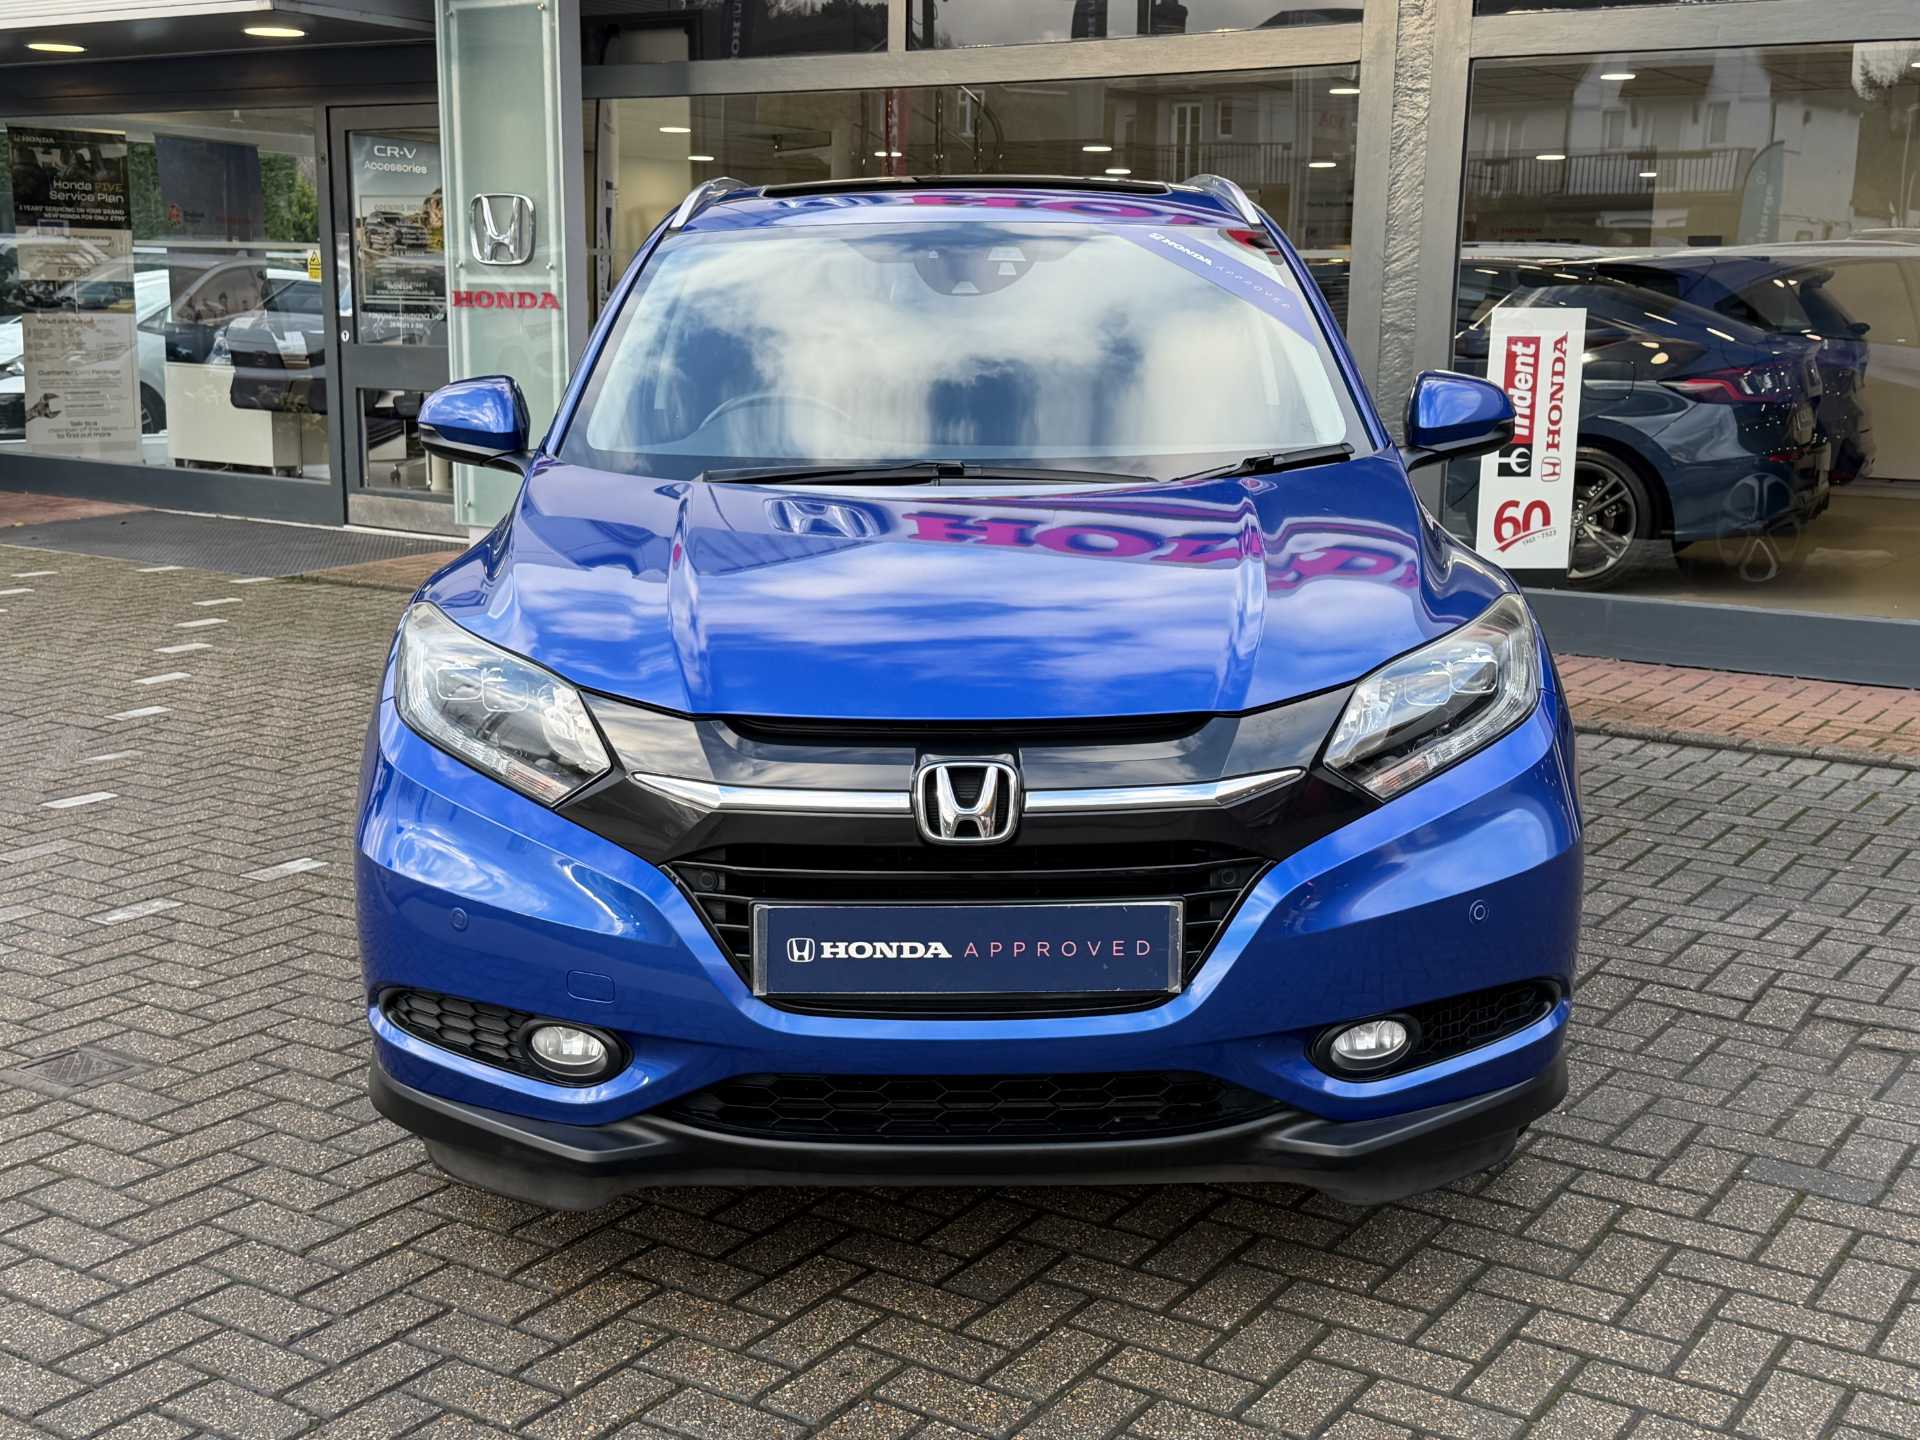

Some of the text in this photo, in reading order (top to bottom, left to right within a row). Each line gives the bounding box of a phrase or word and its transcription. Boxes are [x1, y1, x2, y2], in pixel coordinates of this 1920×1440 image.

[363, 160, 428, 174] Accessories
[53, 179, 92, 191] Honda
[49, 190, 124, 203] Service Plan
[452, 290, 561, 310] HONDA
[1546, 331, 1568, 452] HONDA
[1493, 499, 1551, 545] 60
[820, 940, 1152, 959] HONDA APPROVED
